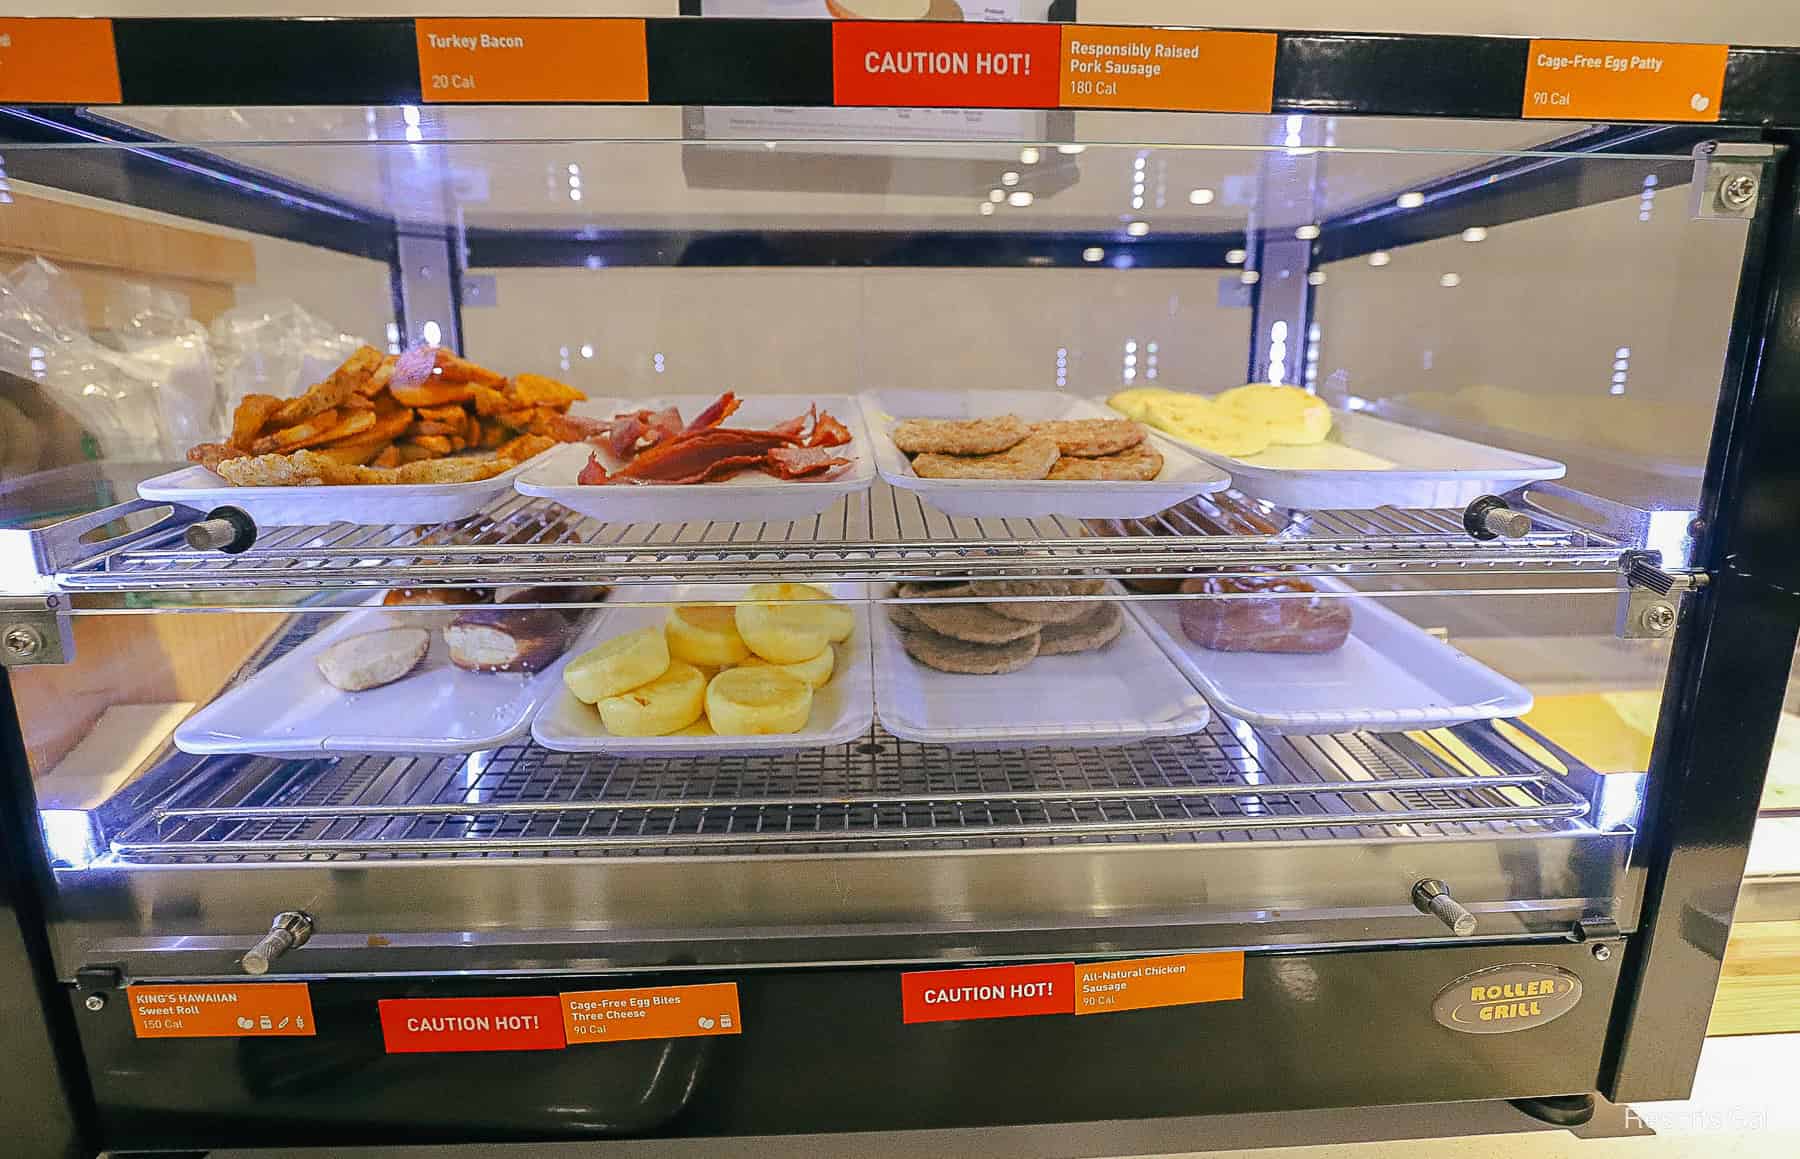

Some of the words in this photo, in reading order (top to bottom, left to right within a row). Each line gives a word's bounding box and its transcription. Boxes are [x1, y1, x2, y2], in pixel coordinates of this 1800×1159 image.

[428, 33, 477, 51] Turkey
[480, 34, 523, 48] Bacon
[1071, 41, 1152, 59] Responsibly
[1155, 44, 1200, 58] Raised
[864, 51, 968, 74] CAUTION
[976, 53, 1031, 75] HOT!
[1070, 59, 1101, 72] Pork
[1105, 60, 1161, 77] Sausage
[1537, 54, 1602, 69] Cage-Free
[1604, 56, 1628, 71] Egg
[1630, 57, 1663, 72] Patty
[432, 74, 449, 88] 20
[452, 74, 475, 88] Cal
[1071, 80, 1093, 94] 180
[1095, 81, 1117, 95] Cal
[1533, 92, 1548, 105] 90
[1550, 92, 1570, 105] Cal
[1083, 968, 1142, 982] All-Natural
[1144, 964, 1187, 976] Chicken
[924, 985, 1005, 1003] CAUTION
[1010, 982, 1053, 999] HOT!
[1082, 982, 1127, 993] Sausage
[1471, 980, 1554, 1001] ROLLER
[136, 993, 177, 1004] KING'S
[179, 993, 237, 1003] HAWAIIAN
[570, 1000, 627, 1011] Cage-Free
[629, 998, 650, 1008] Egg
[653, 996, 681, 1006] Bites
[1083, 997, 1096, 1006] 90
[1098, 996, 1115, 1005] Cal
[139, 1006, 174, 1016] Sweet
[177, 1005, 200, 1015] Roll
[571, 1011, 604, 1021] Three
[606, 1009, 646, 1020] Cheese
[1480, 1002, 1541, 1021] GRILL
[143, 1020, 162, 1029] 150
[164, 1019, 184, 1029] Cal
[407, 1017, 490, 1032] CAUTION
[495, 1015, 539, 1030] HOT!
[574, 1026, 587, 1035] 90
[589, 1025, 607, 1034] Cal
